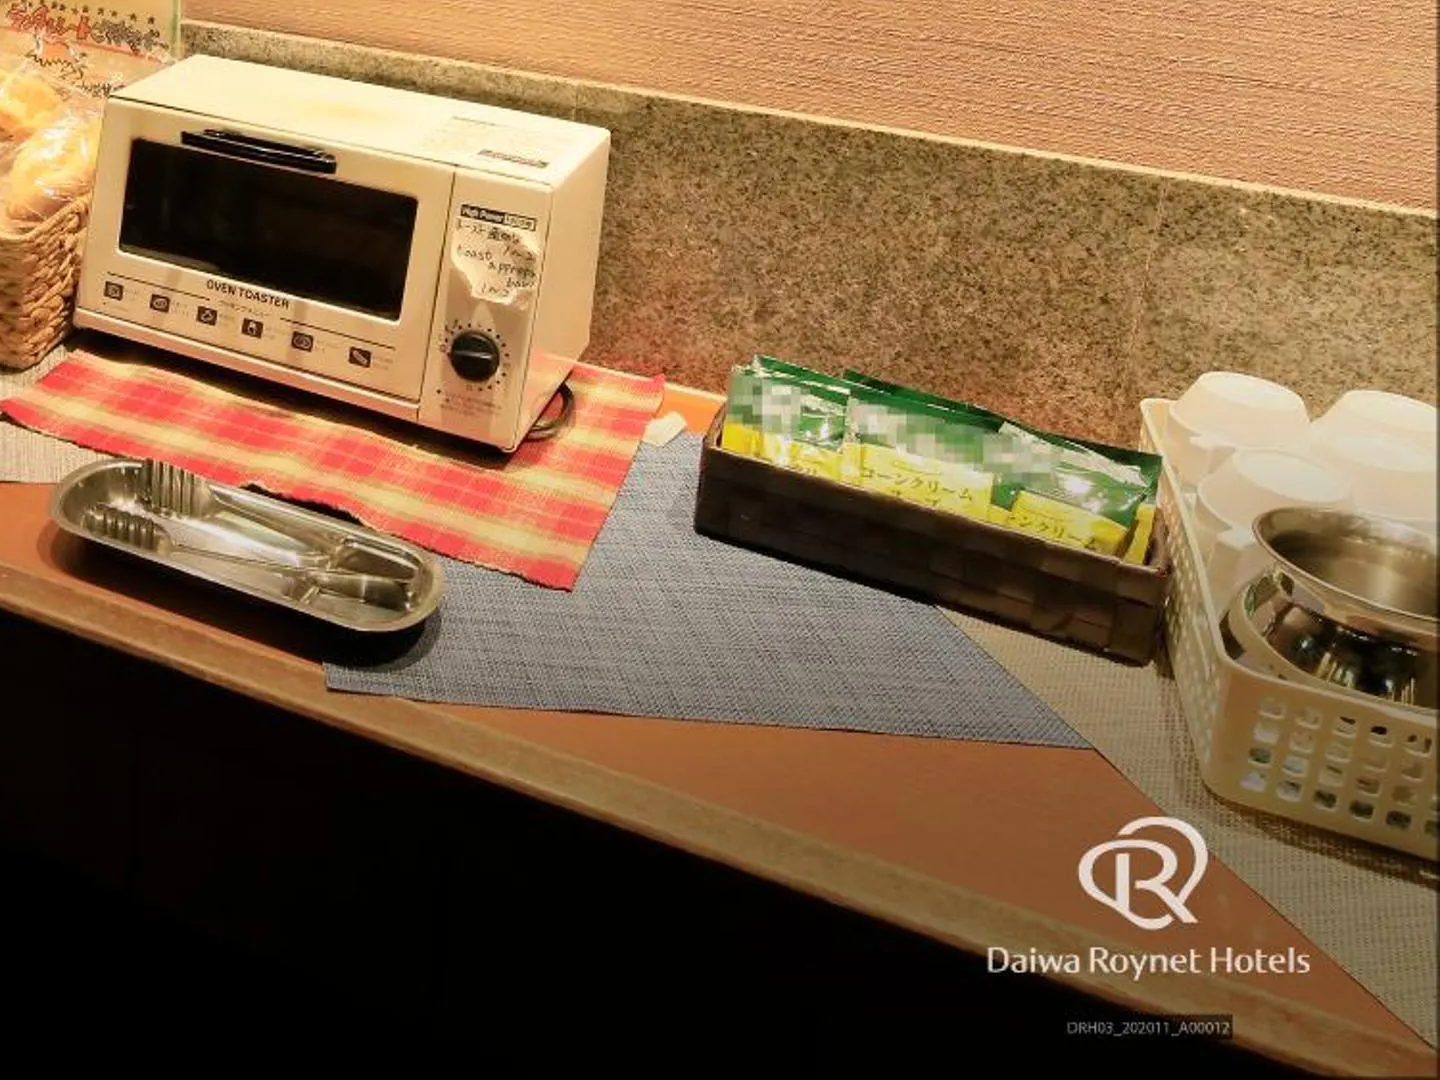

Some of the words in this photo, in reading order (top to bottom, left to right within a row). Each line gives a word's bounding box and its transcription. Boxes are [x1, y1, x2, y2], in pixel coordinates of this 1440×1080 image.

[207, 279, 236, 295] OVEN
[238, 287, 289, 309] TOASTER
[860, 468, 973, 501] コーンクリーム
